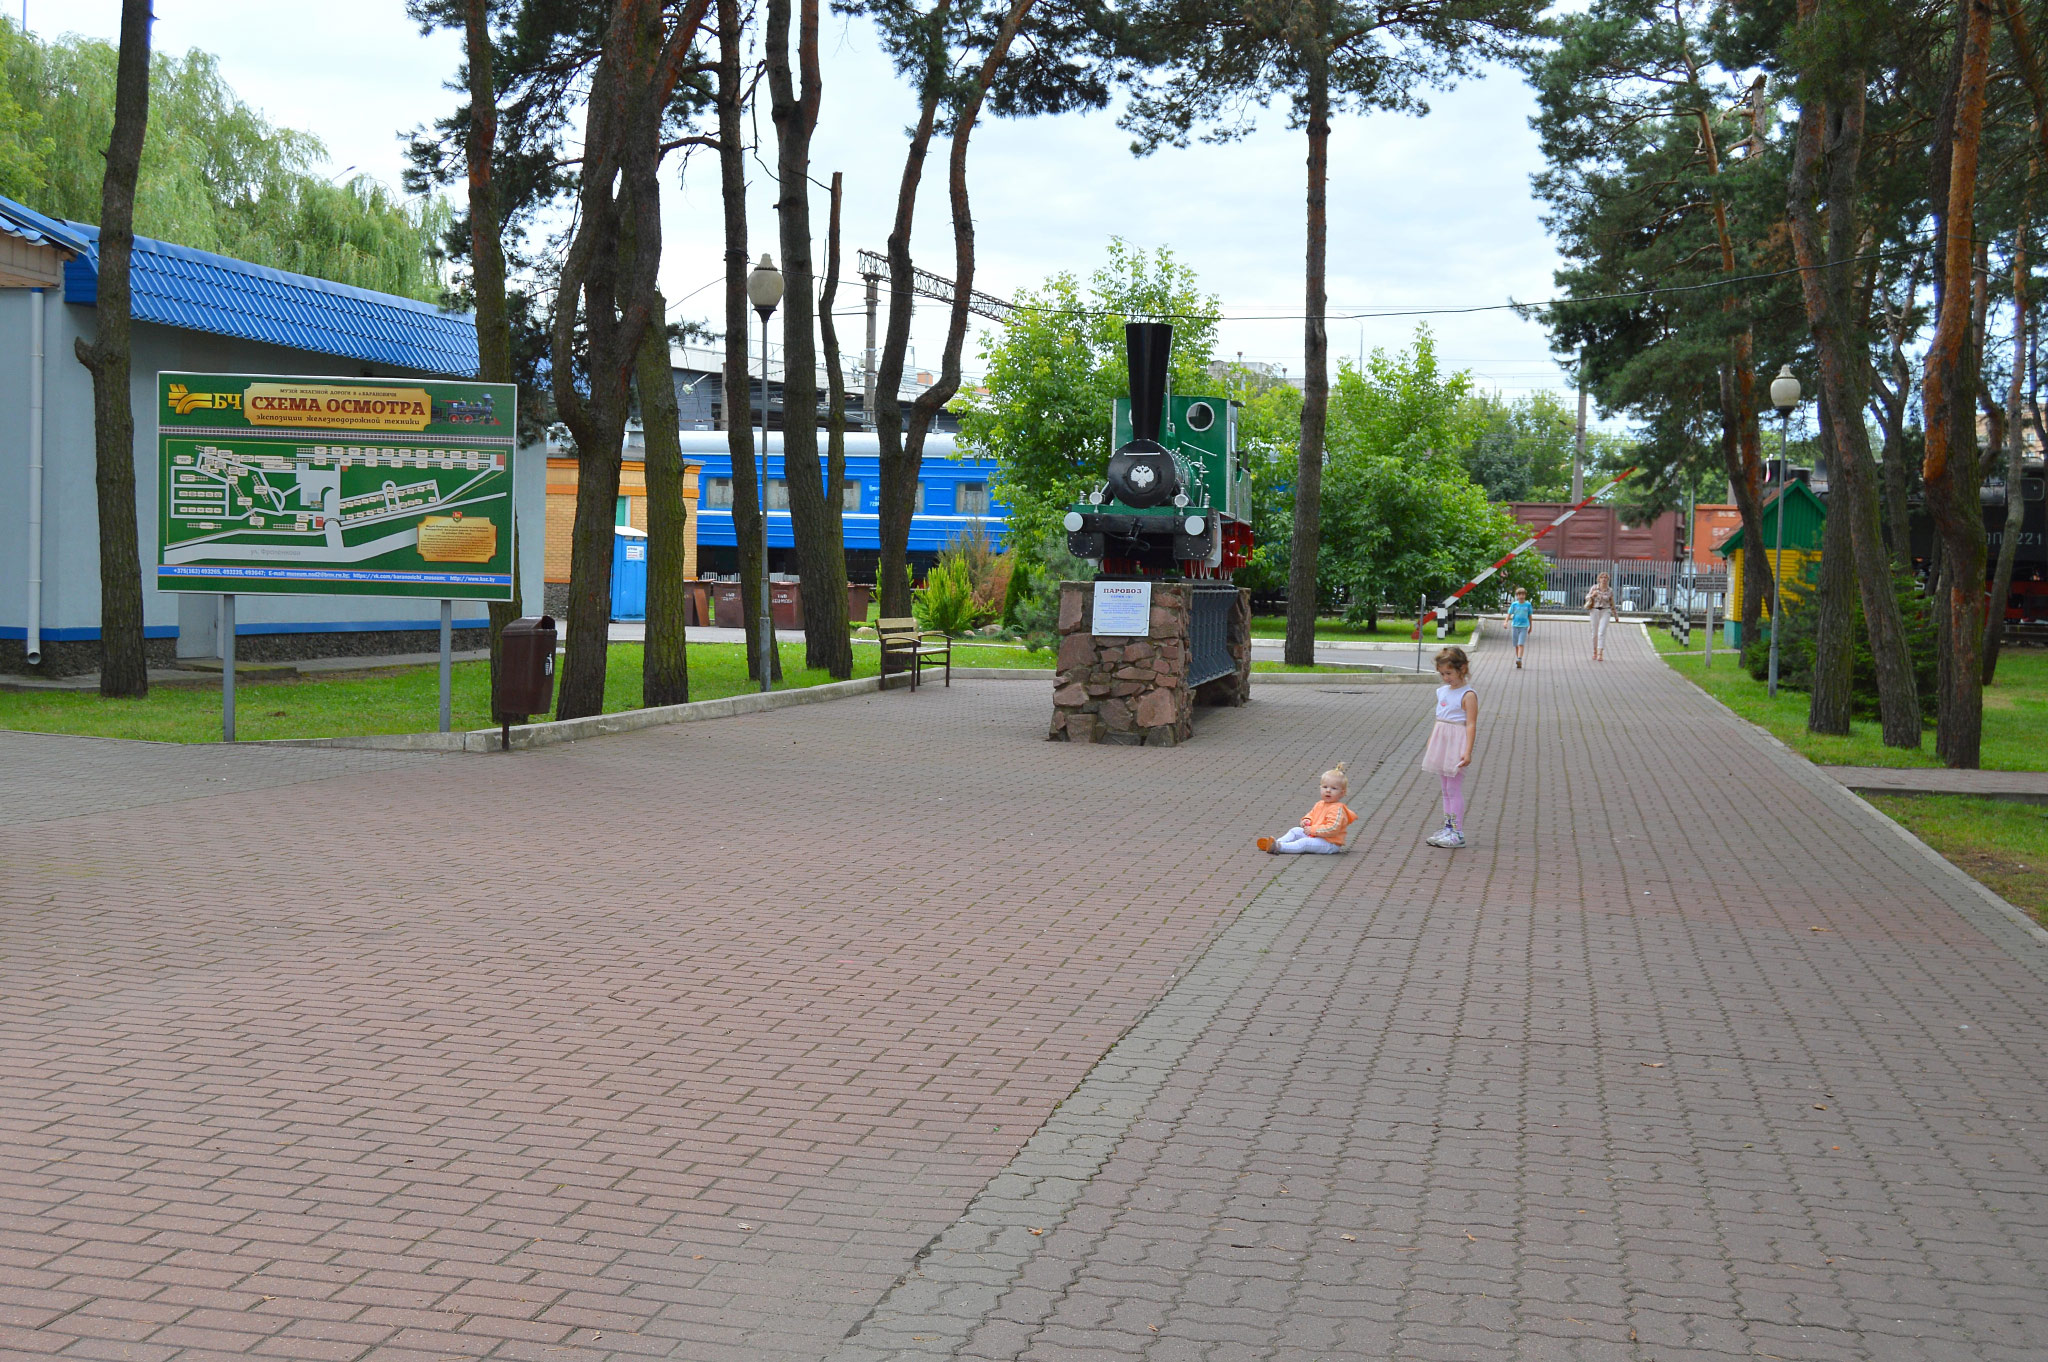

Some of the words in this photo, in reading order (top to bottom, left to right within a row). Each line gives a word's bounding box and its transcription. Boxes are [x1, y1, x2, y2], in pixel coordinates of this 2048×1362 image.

[212, 393, 242, 410] БЧ
[251, 396, 322, 412] СХЕМА
[326, 398, 426, 416] ОСМОТРА
[256, 414, 303, 423] экспозиции
[306, 415, 381, 425] железнодорожной
